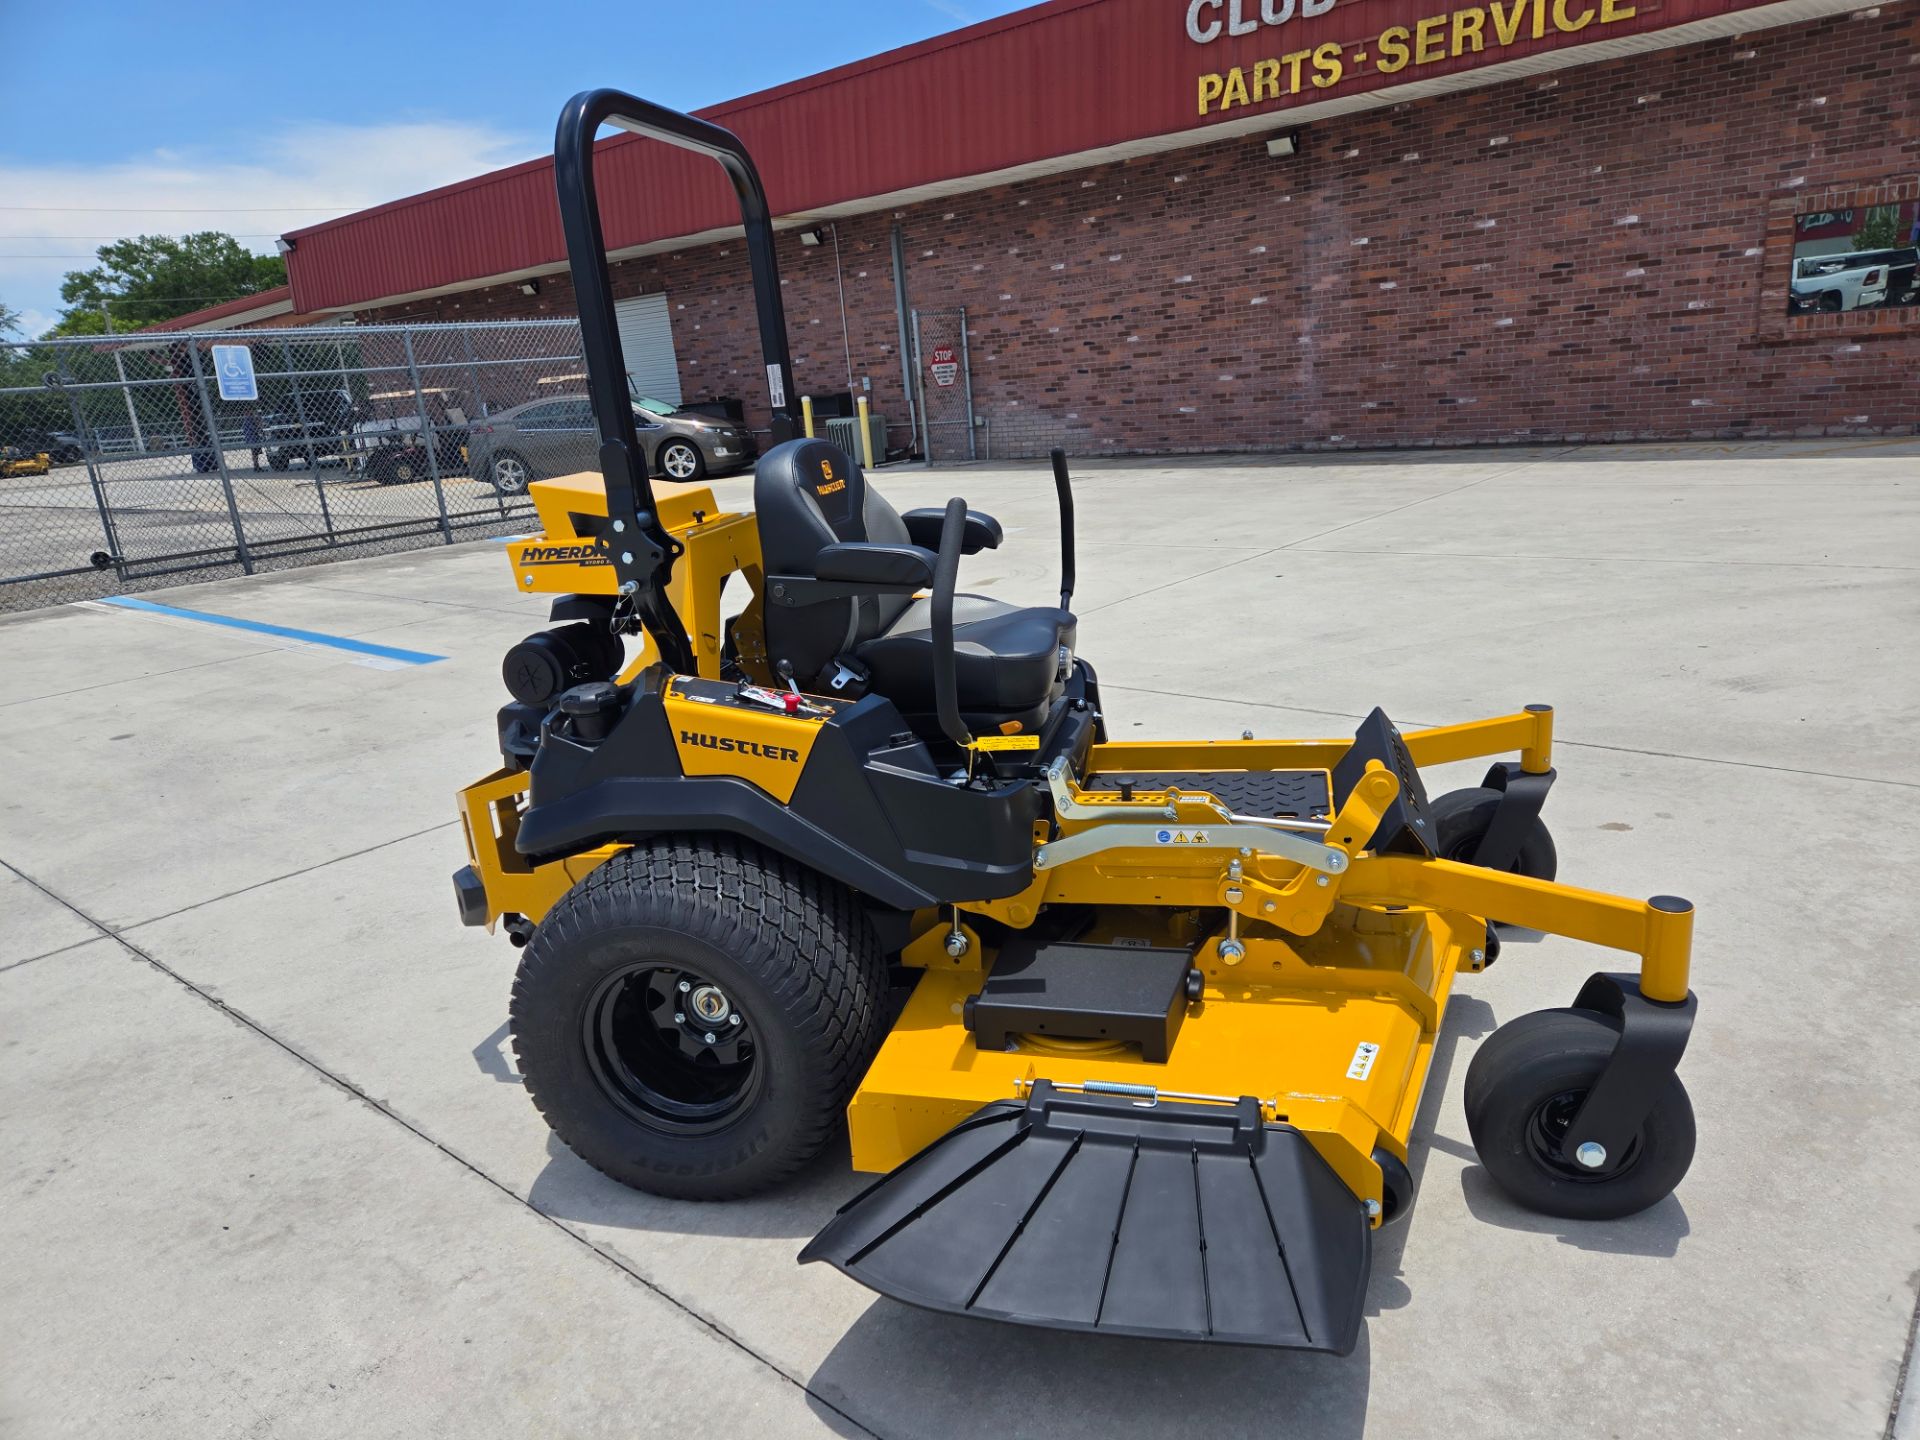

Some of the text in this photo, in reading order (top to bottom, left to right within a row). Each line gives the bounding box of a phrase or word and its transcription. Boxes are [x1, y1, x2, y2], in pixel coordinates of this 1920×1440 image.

[1199, 43, 1343, 115] PARTS
[934, 350, 953, 362] STOP
[521, 545, 604, 560] HYPERD
[681, 731, 799, 762] HUSTLER
